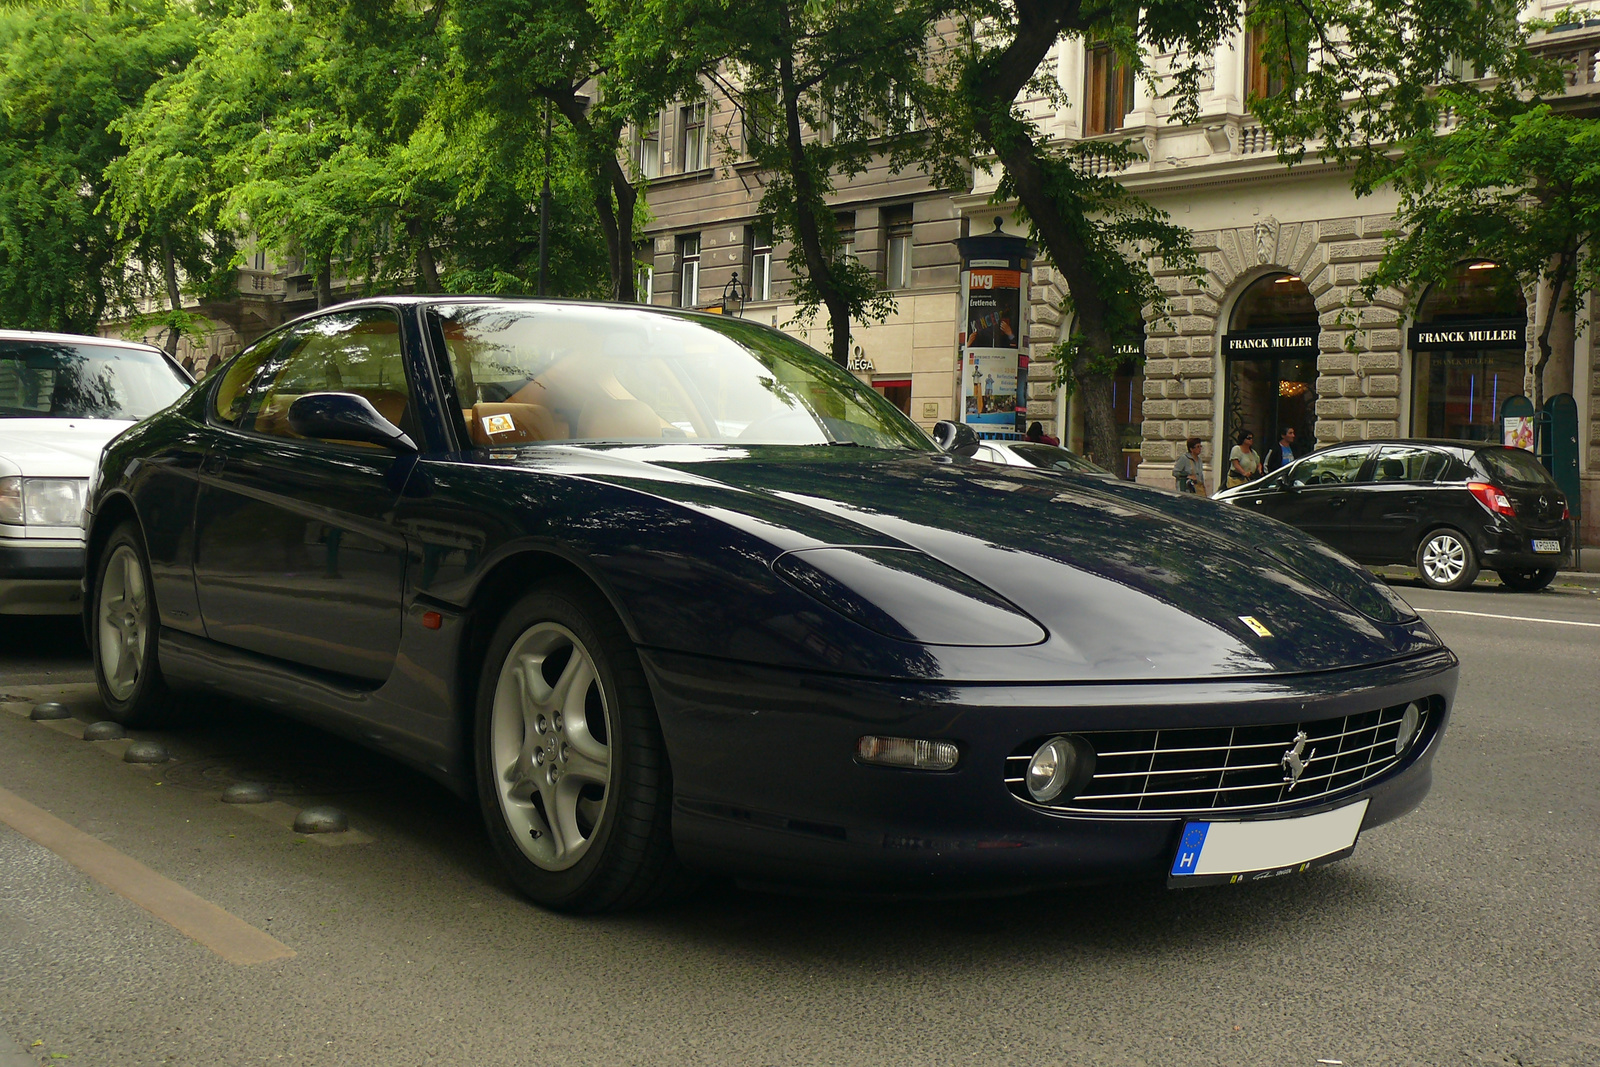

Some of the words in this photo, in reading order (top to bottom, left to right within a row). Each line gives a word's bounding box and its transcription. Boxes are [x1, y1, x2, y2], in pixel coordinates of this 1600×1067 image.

[971, 273, 993, 289] hvg
[1229, 338, 1269, 349] FRANCK
[1271, 337, 1312, 348] MULLER
[1418, 332, 1465, 343] FRANCK
[1468, 330, 1517, 341] MULLER
[847, 359, 874, 370] MEGA
[1179, 852, 1194, 868] H
